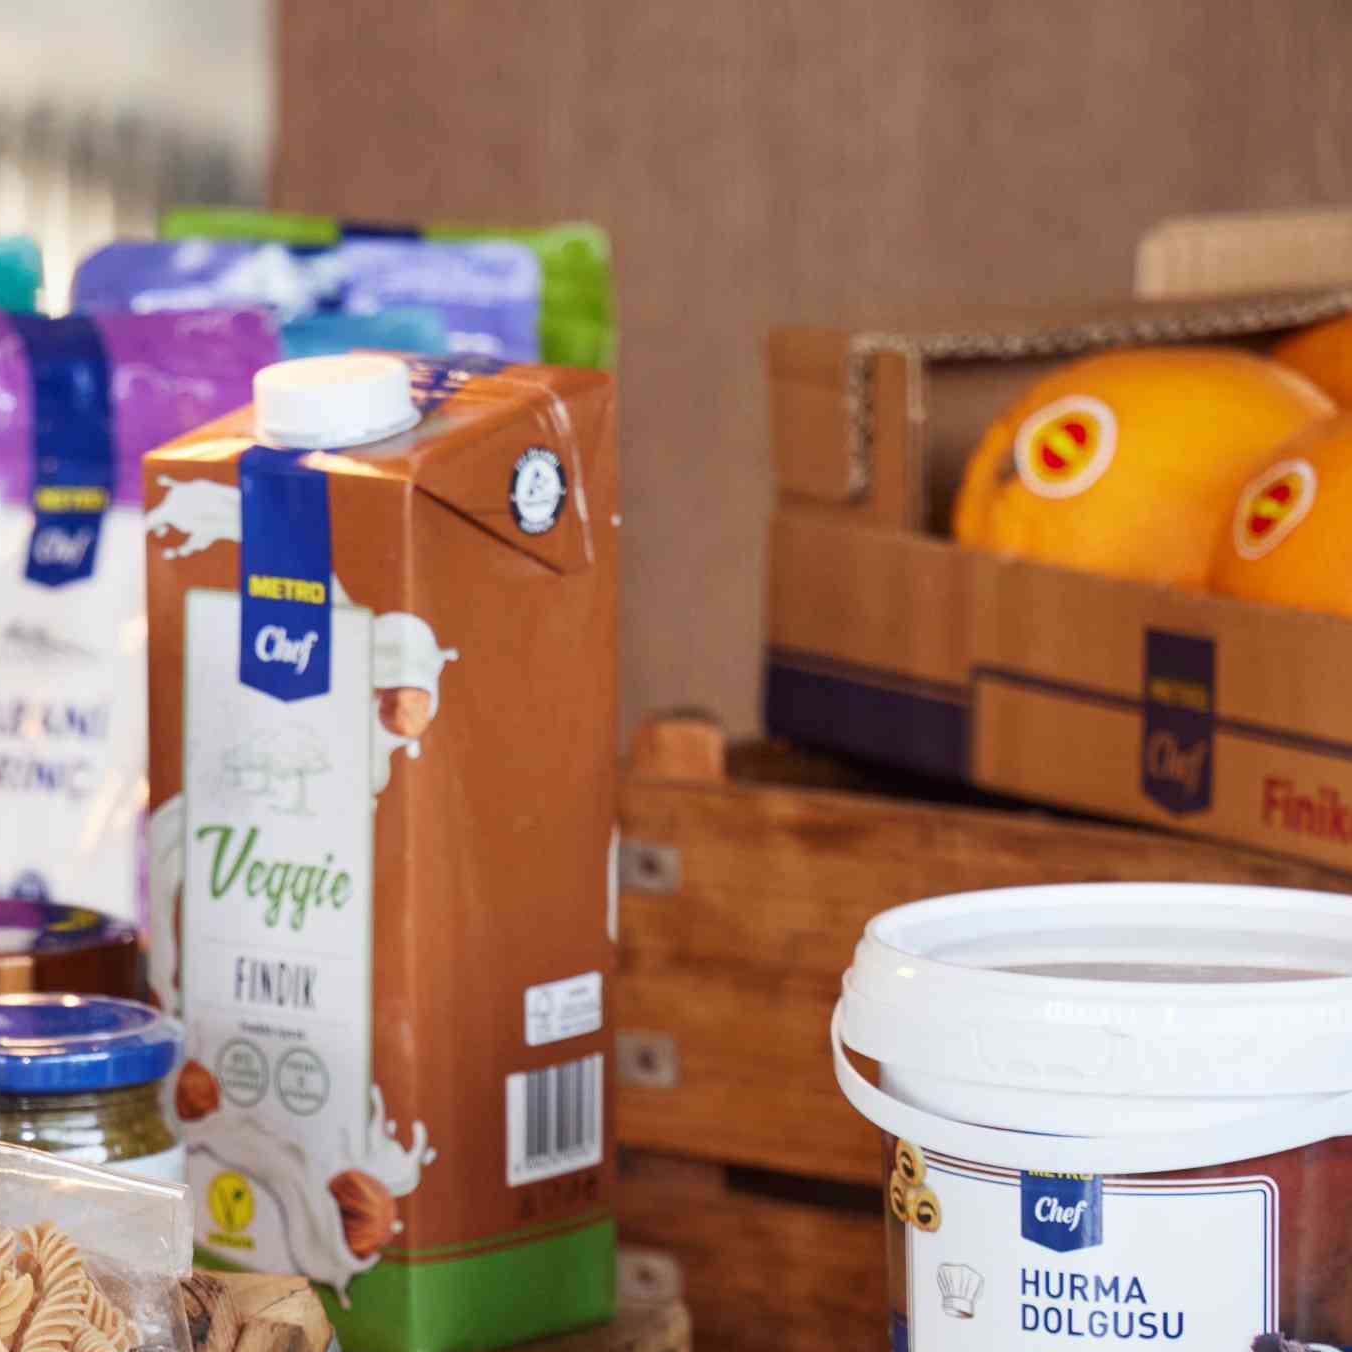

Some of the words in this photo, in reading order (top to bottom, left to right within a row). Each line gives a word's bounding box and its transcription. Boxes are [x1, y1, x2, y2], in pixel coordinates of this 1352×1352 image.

[248, 576, 326, 605] METRO
[255, 626, 319, 673] Chef
[195, 824, 351, 931] Veggie
[233, 956, 320, 1010] FINDIK
[1034, 1196, 1089, 1232] Chef
[1021, 1268, 1147, 1304] HURMA
[1021, 1303, 1185, 1339] DOLGUSU
